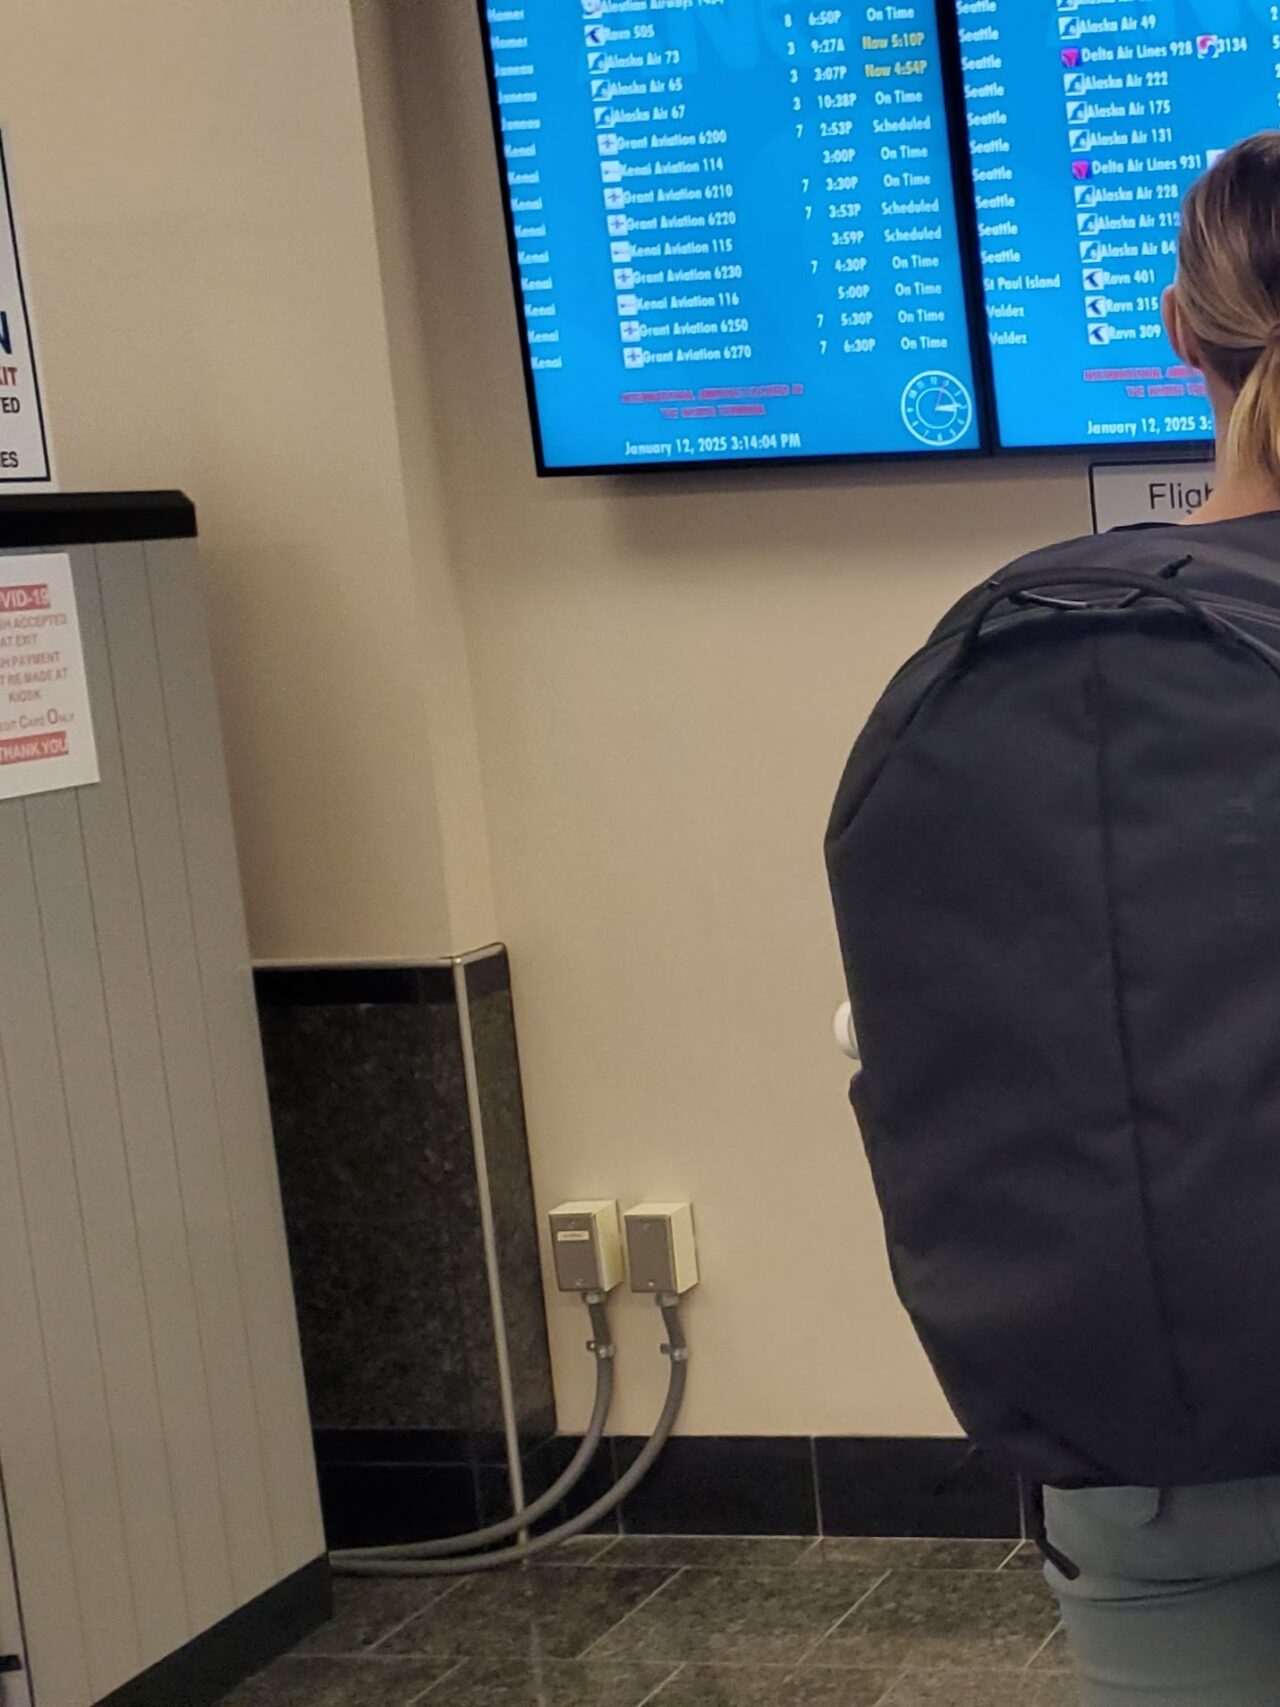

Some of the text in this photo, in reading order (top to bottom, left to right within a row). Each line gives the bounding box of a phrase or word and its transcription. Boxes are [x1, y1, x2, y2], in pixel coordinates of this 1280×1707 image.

[961, 54, 1002, 71] Seattle
[1082, 46, 1114, 63] Delta
[1117, 45, 1133, 60] Air
[1136, 44, 1167, 59] Lines
[1169, 40, 1193, 56] 928
[1218, 37, 1248, 53] 3134
[1272, 34, 1280, 49] 5
[964, 82, 1005, 99] Seattle
[1085, 74, 1123, 91] Alaska
[1126, 73, 1143, 87] Air
[1145, 71, 1168, 87] 222
[966, 110, 1007, 126] Seattle
[1087, 102, 1126, 119] Alaska
[1128, 101, 1145, 116] Air
[1149, 99, 1171, 114] 175
[651, 134, 696, 148] Aviation
[698, 129, 727, 144] 6200
[796, 124, 803, 138] 7
[820, 120, 853, 137] 2:53P
[873, 115, 931, 133] Scheduled
[997, 275, 1023, 290] Paul
[1025, 274, 1061, 289] Island
[1133, 269, 1155, 283] 401
[986, 304, 1024, 318] Valdez
[1137, 296, 1158, 311] 315
[527, 308, 945, 343] Kenai Grant Aviation 6250 7 5:30P On Time
[530, 336, 948, 369] Kenai Grant Aviation 6270 7 6:30P On Time
[1087, 416, 1196, 436] January 12, 2025
[625, 433, 801, 456] January 12, 2025 3:14:04 PM
